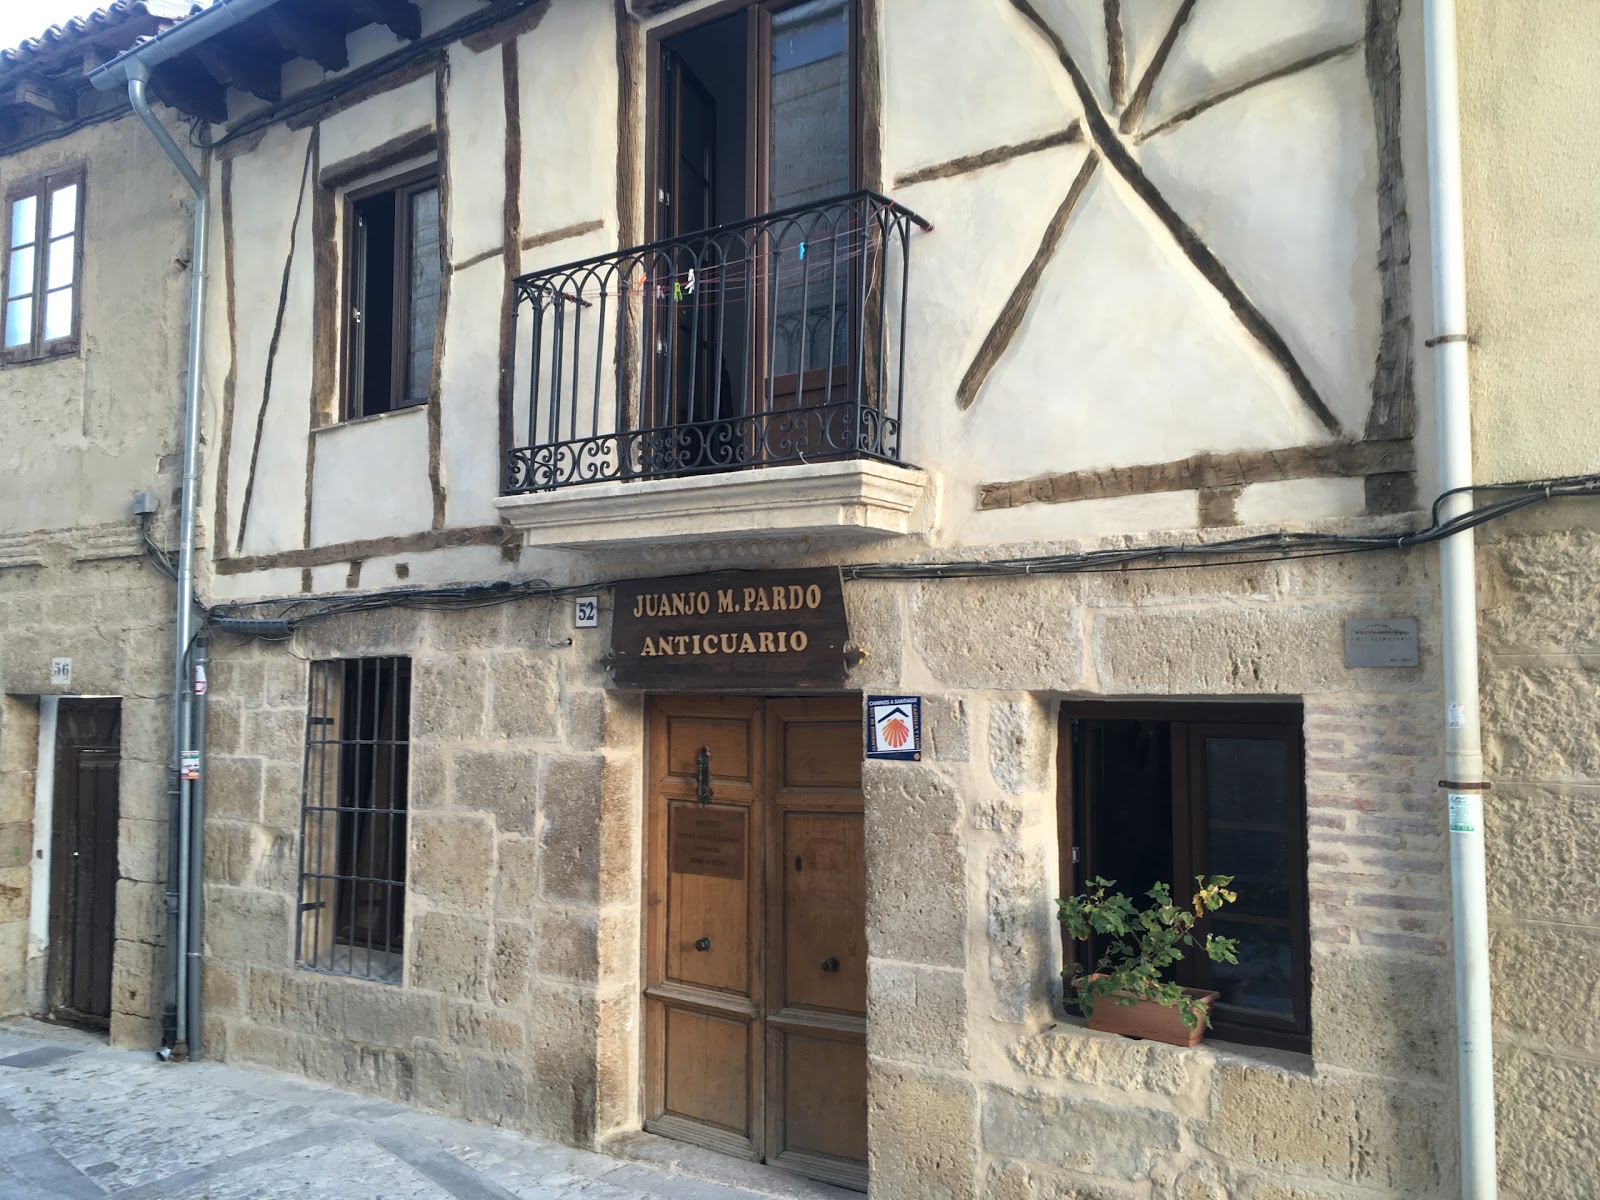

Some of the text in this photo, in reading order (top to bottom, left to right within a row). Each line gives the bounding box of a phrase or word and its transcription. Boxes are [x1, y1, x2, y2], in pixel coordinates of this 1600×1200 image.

[578, 601, 595, 621] 52
[633, 591, 710, 618] JUANJO
[743, 584, 822, 611] PARDO
[640, 630, 808, 657] ANTICUARIO
